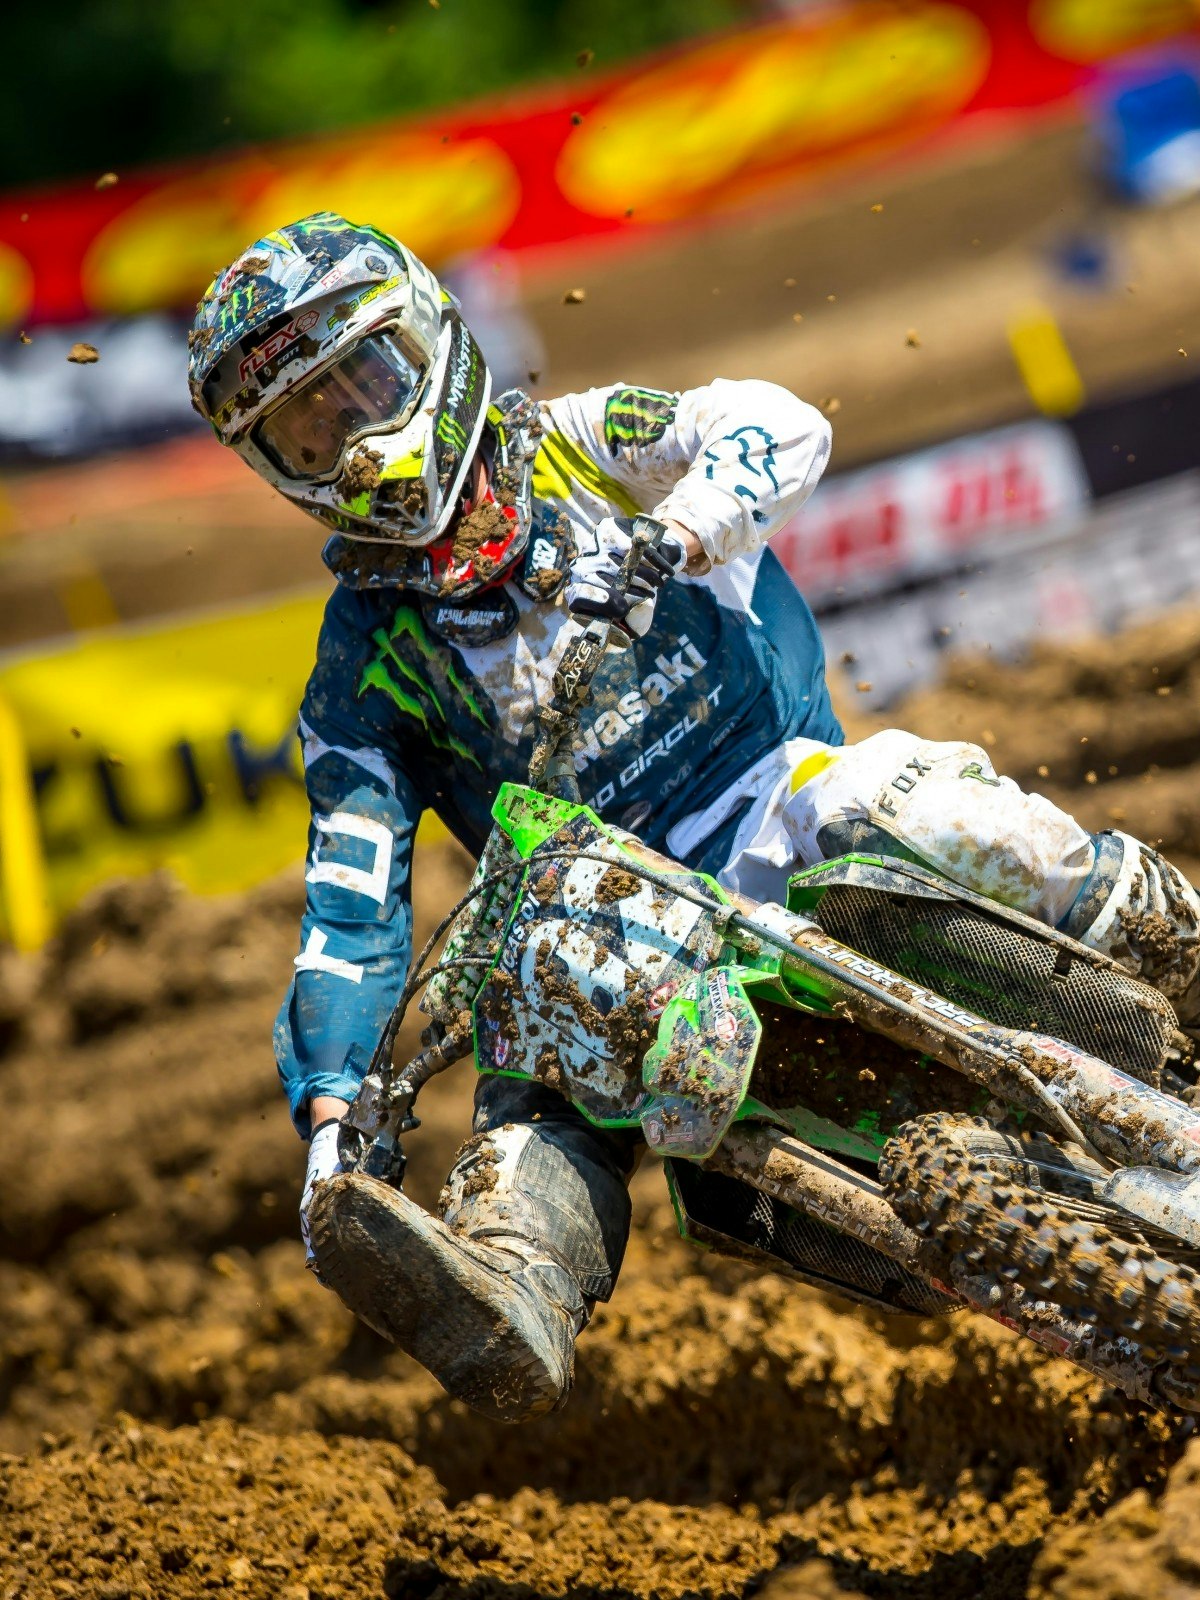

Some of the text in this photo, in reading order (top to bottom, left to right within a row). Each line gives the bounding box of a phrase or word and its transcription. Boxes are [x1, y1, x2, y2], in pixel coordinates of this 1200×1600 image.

[239, 322, 297, 383] FLEX
[574, 634, 708, 774] wasaki
[878, 757, 931, 818] FOX
